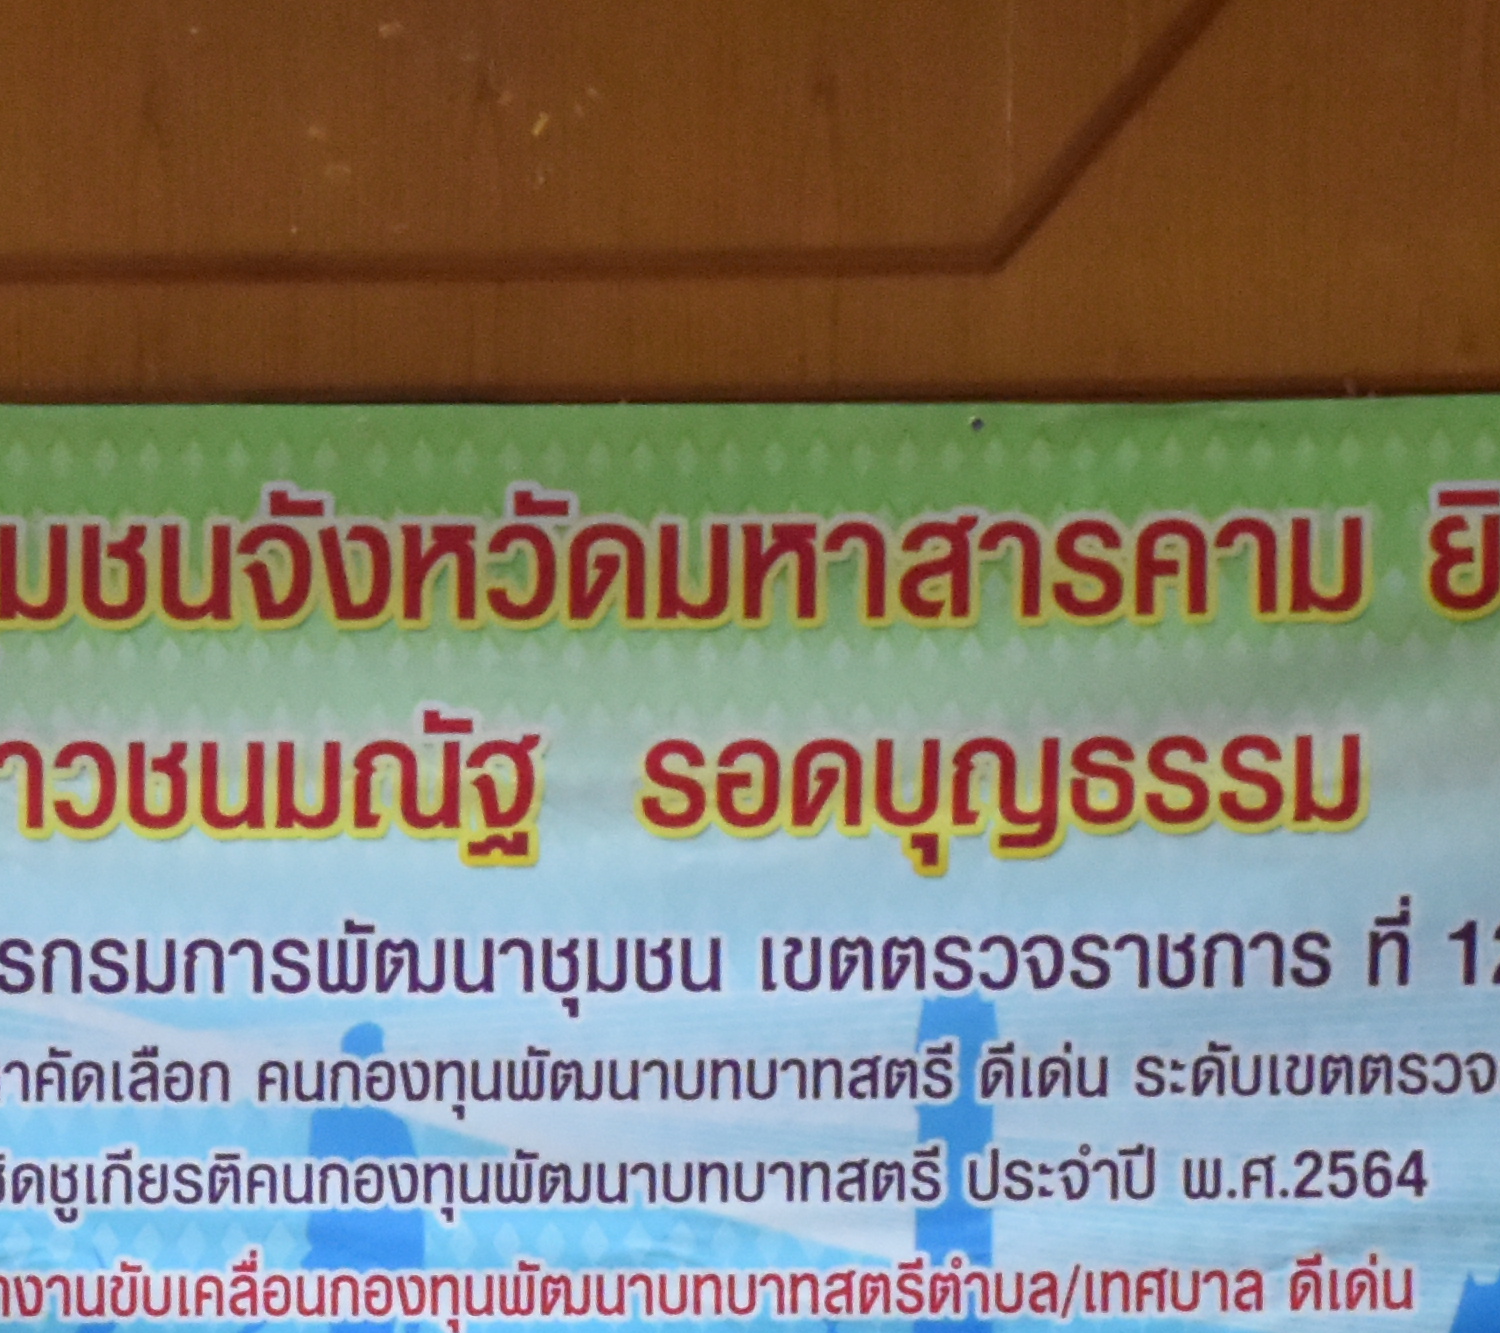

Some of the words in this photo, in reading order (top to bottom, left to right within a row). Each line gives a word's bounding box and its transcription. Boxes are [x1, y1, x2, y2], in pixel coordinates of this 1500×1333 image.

[641, 733, 1363, 869] รอดบุญธรรม
[761, 930, 1335, 995] เขตตรวจราชการ
[1367, 894, 1414, 990] ที่
[257, 1041, 956, 1123] คนกองทุนพัฒนาบทบาทสตรี
[980, 1040, 1111, 1101] ดีเด่น
[968, 1142, 1158, 1205] ประจำปี
[1183, 1148, 1430, 1203] พ.ศ.2564
[1289, 1254, 1415, 1313] ดีเด่น
